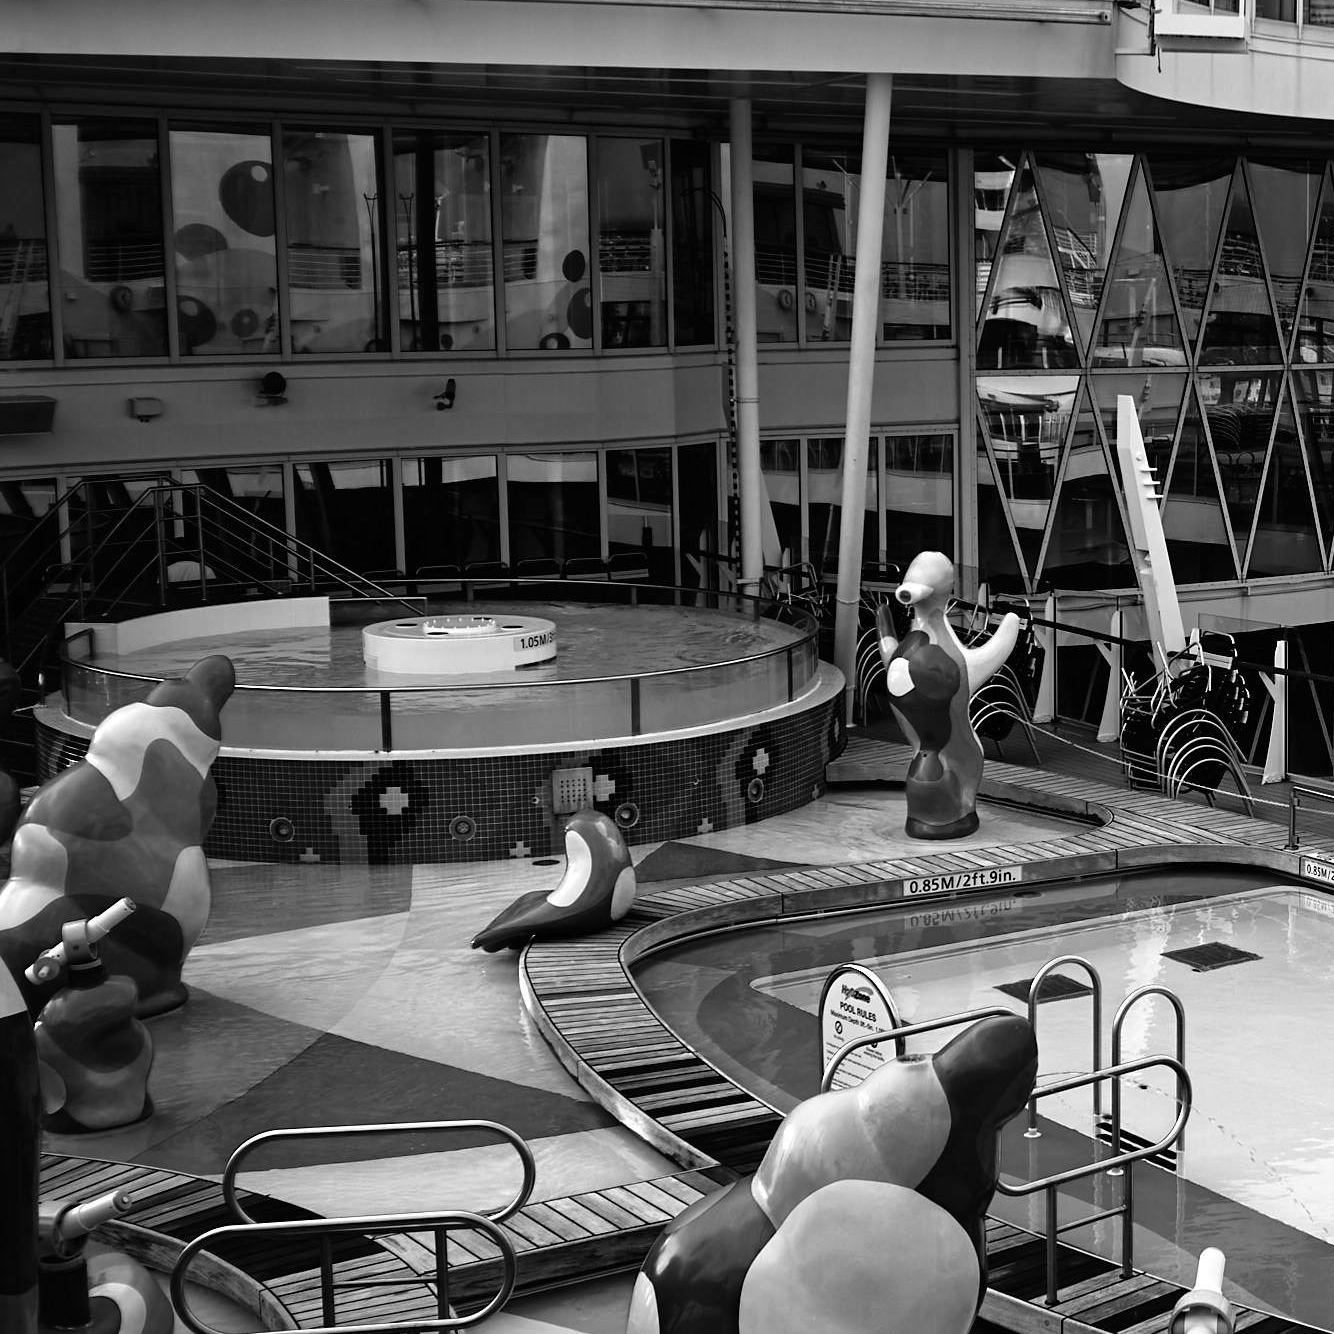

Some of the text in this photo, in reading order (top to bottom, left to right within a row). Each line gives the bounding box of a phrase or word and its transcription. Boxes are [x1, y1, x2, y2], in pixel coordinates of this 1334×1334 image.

[909, 869, 1016, 894] 0.85M/2ft.9in.
[840, 1001, 877, 1023] POOL RULES
